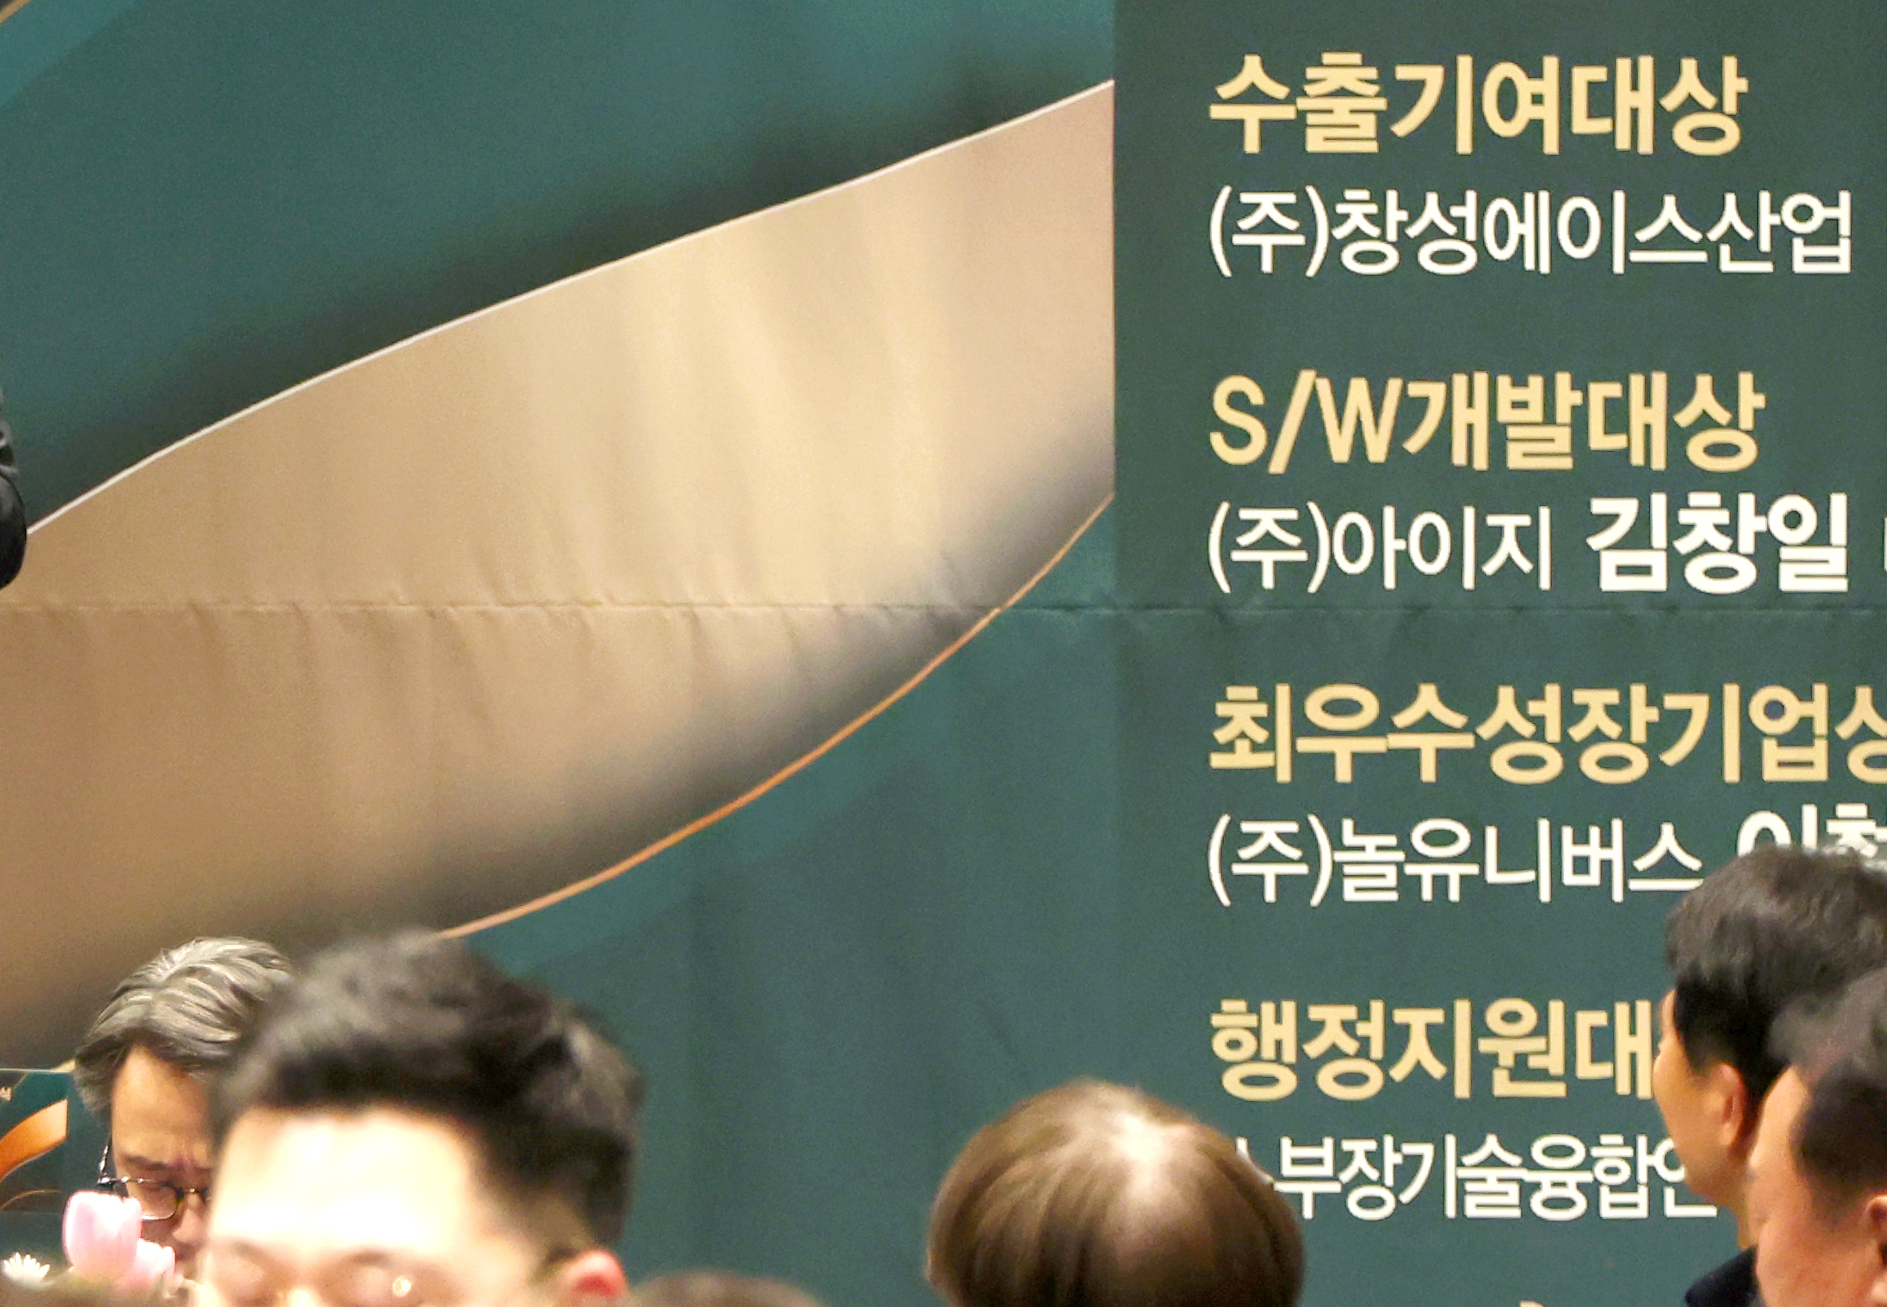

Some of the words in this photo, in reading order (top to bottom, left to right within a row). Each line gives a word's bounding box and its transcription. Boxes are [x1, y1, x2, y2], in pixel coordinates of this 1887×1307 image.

[1210, 52, 1748, 155] 수출기여대상
[1210, 186, 1851, 277] (주)창성에이스산업
[1210, 369, 1765, 474] S/W개발대상
[1209, 502, 1551, 593] (주)아이지
[1586, 492, 1848, 594] 김창일
[1209, 814, 1704, 906] (주)놀유니버스
